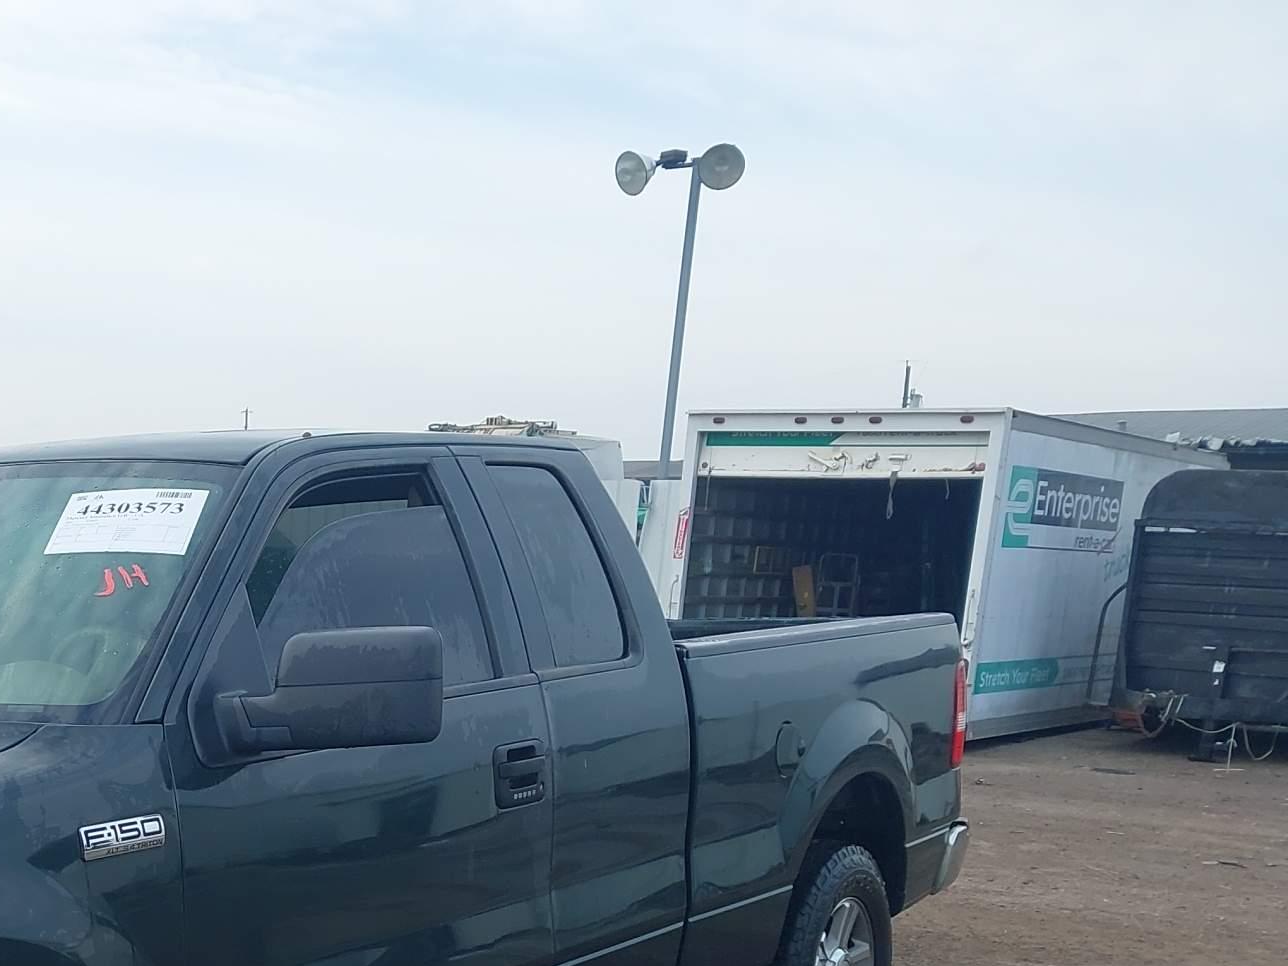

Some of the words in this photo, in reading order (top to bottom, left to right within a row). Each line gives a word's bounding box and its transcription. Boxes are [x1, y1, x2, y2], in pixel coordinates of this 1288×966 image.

[77, 502, 184, 515] 44303573
[1034, 480, 1120, 530] Enterprise
[94, 564, 149, 597] JH
[979, 672, 1010, 688] Stretch
[84, 817, 162, 848] F-150
